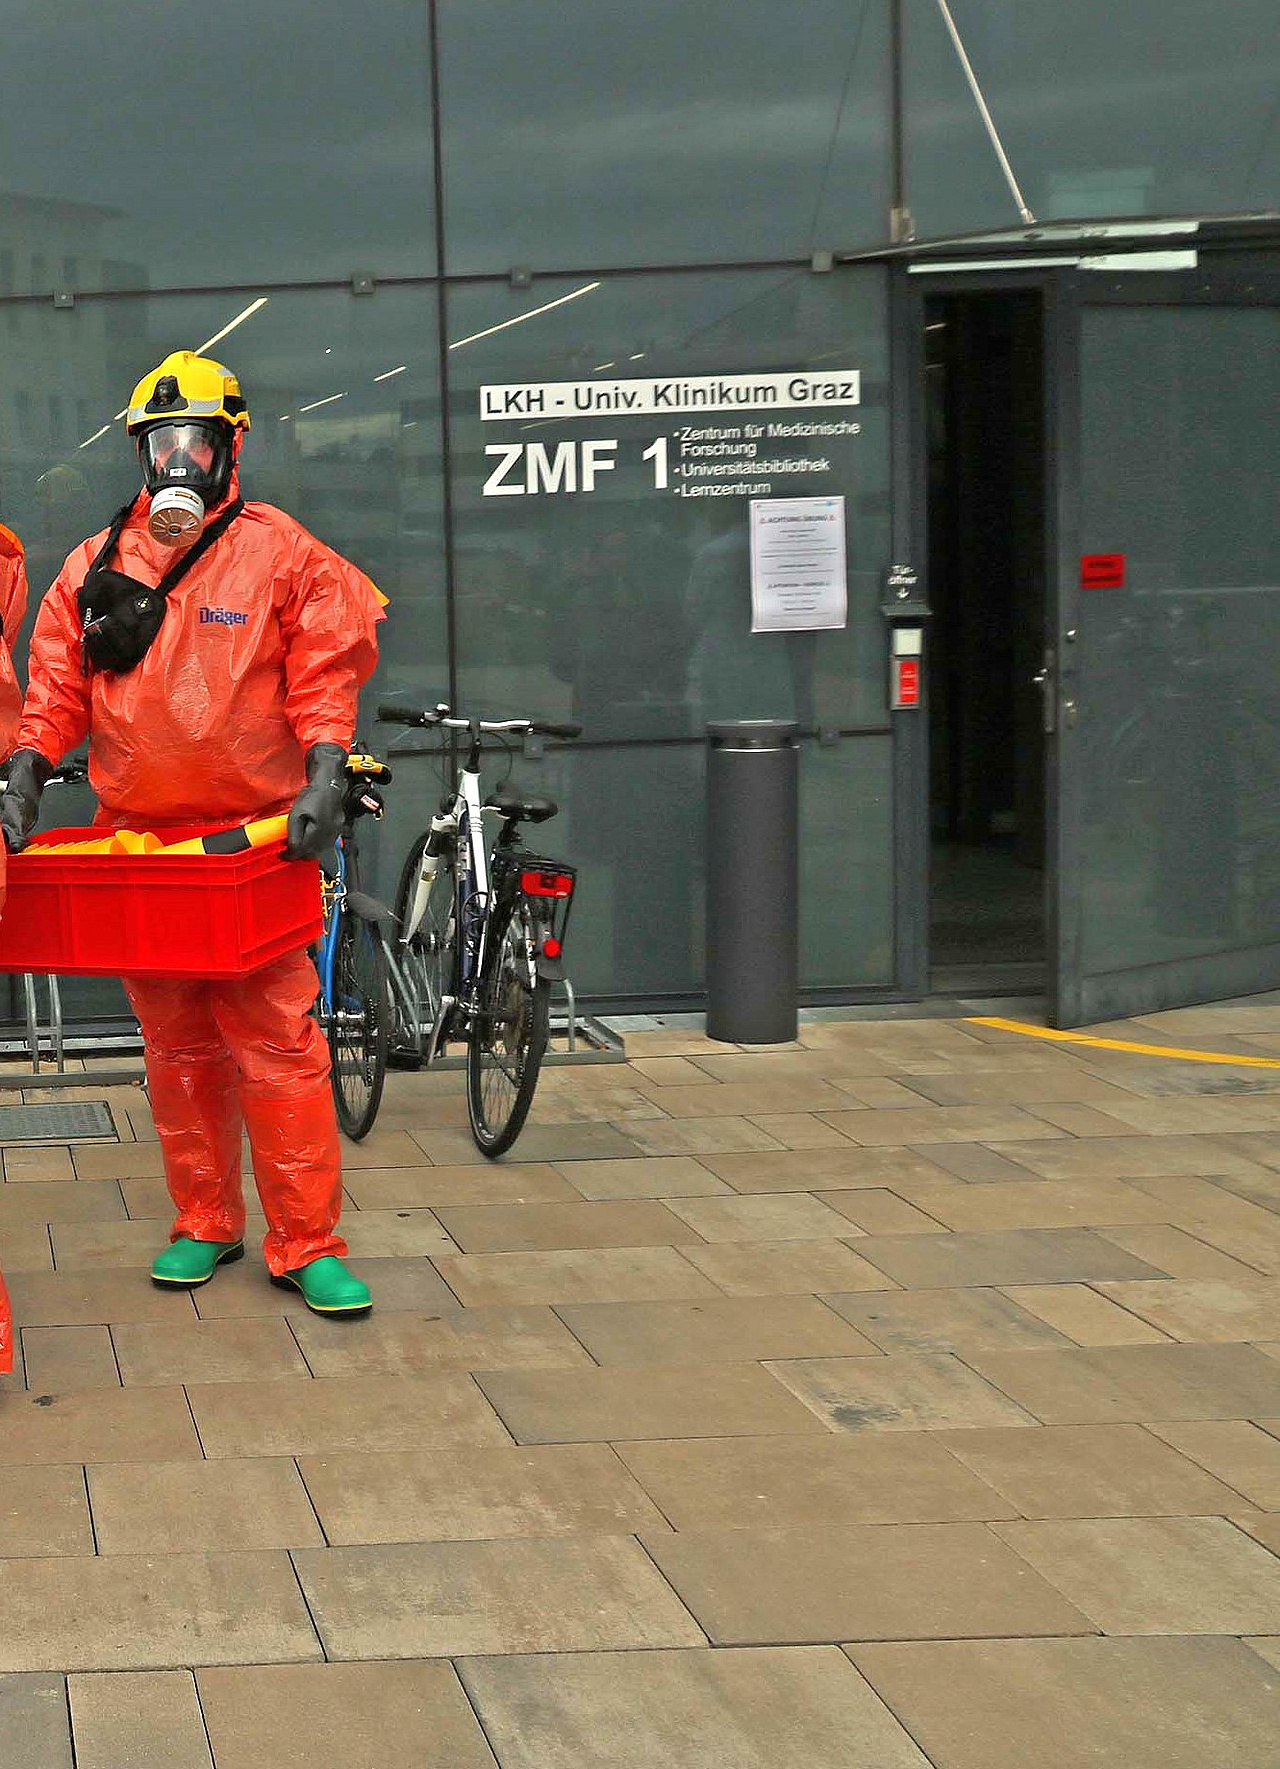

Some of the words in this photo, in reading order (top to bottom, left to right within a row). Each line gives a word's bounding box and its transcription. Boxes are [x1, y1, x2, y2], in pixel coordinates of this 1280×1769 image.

[486, 389, 544, 414] LKH
[574, 386, 643, 411] Univ.
[653, 380, 778, 408] Klinikum
[788, 377, 854, 402] Graz
[680, 426, 741, 442] Zentrum
[744, 424, 765, 439] für
[767, 421, 861, 438] Medizinische
[680, 441, 758, 458] Forschung
[482, 439, 618, 496] ZMF
[642, 437, 669, 489] 1
[680, 458, 832, 477] Universitätsbibliothek
[680, 481, 772, 498] Lernzentrum
[199, 606, 249, 626] Dräger
